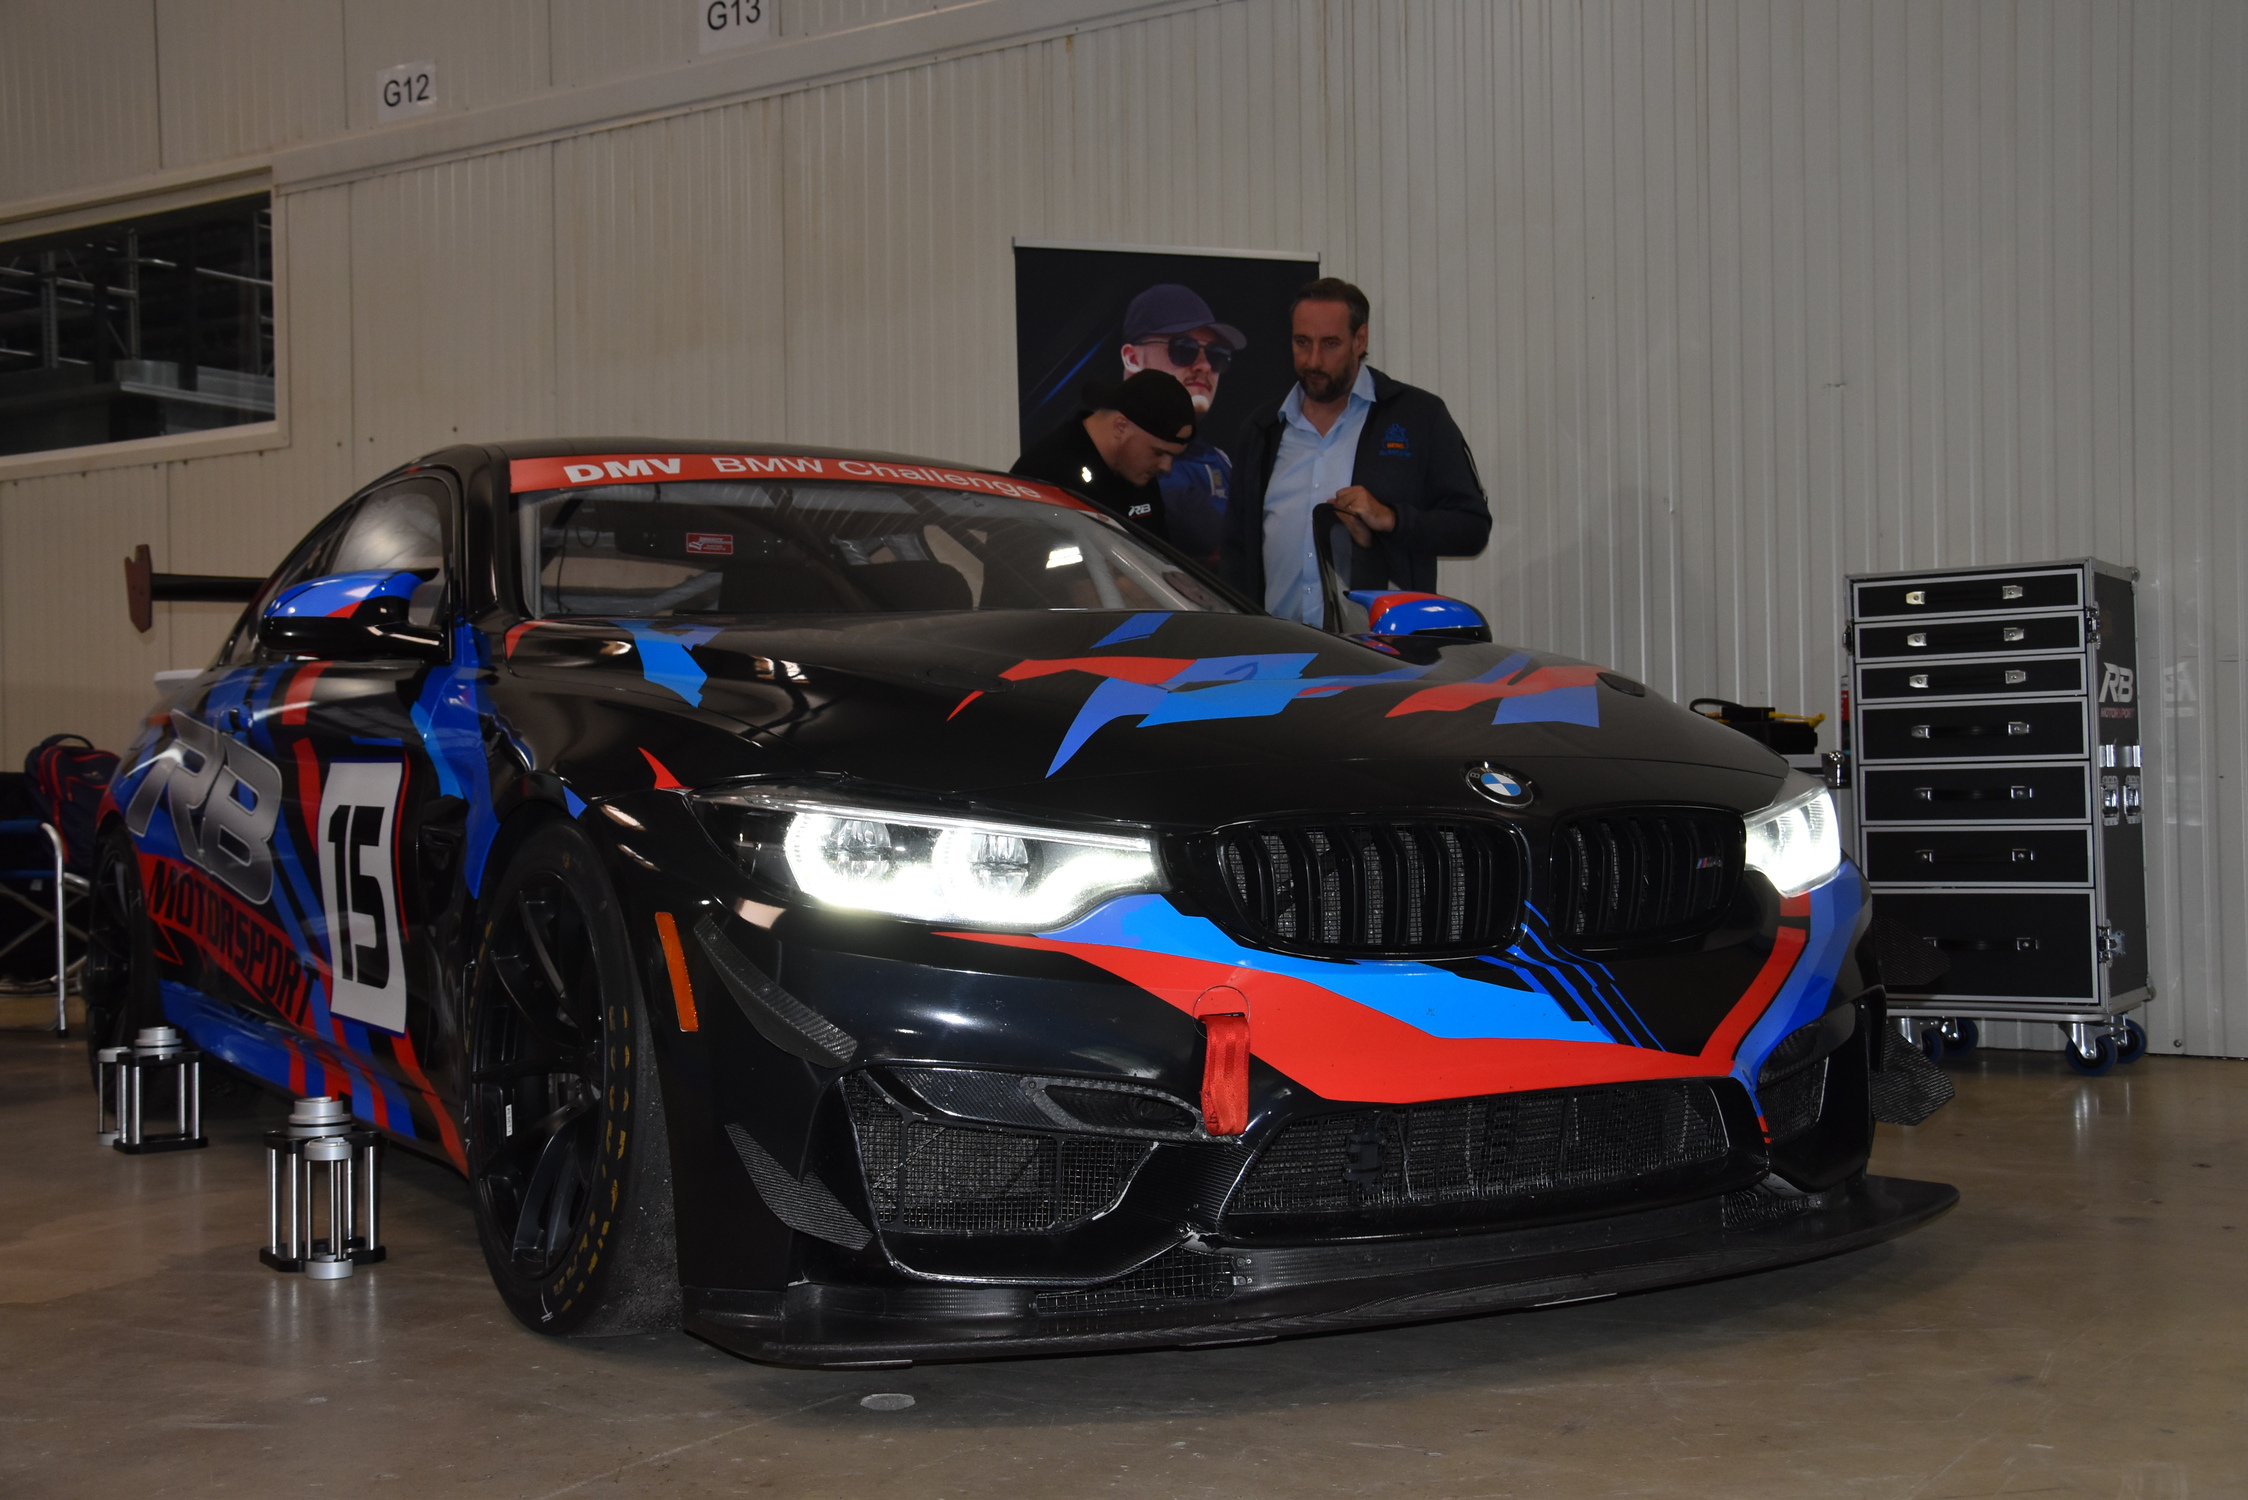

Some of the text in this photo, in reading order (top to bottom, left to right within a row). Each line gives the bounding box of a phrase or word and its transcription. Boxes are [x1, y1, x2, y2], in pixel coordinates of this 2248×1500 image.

[706, 0, 762, 31] G13
[383, 73, 430, 107] G12
[563, 457, 1042, 498] DMV BMW Challenge
[1128, 503, 1151, 517] RB
[2098, 662, 2134, 703] RB
[126, 707, 283, 905] RB
[328, 804, 391, 990] 15
[150, 859, 320, 1026] MOTORSPORT
